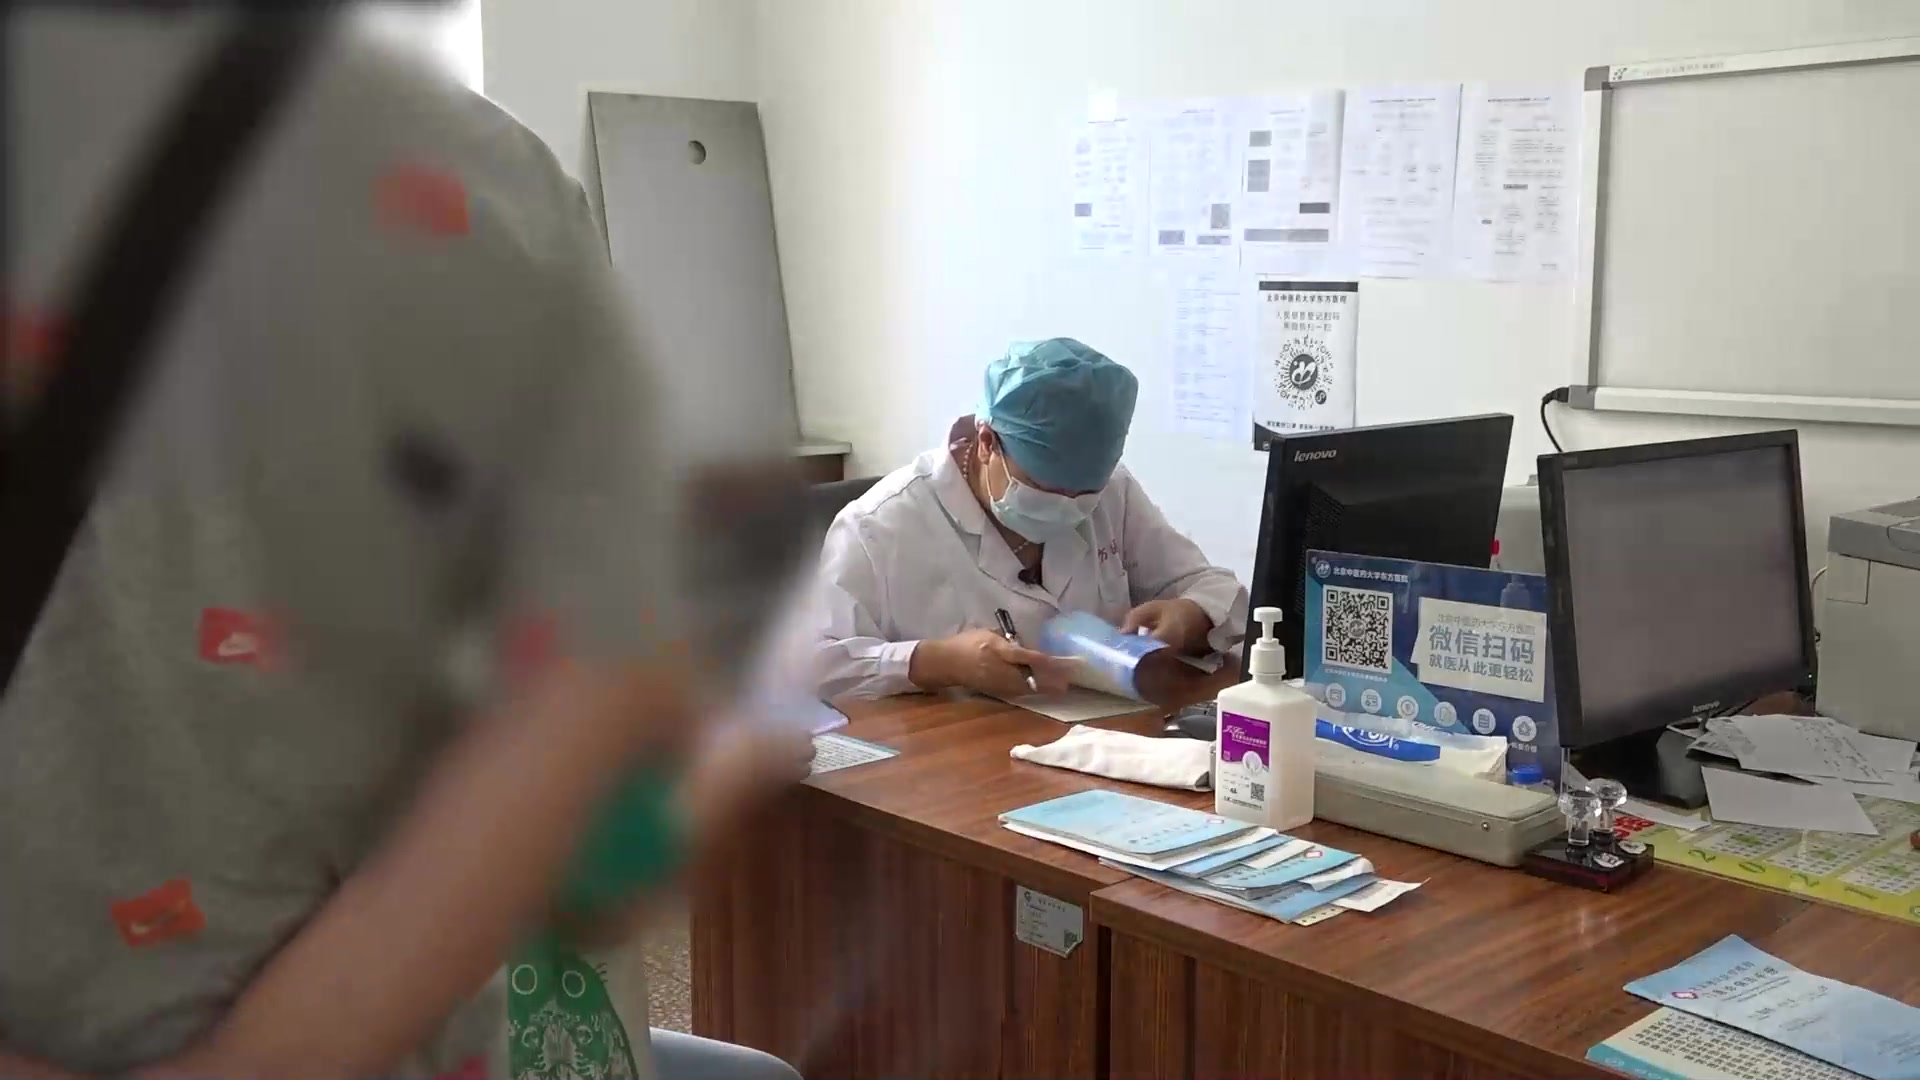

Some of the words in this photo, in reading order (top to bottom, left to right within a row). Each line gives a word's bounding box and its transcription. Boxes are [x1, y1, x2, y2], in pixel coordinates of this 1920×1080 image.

[1294, 450, 1337, 462] lenovo
[1333, 562, 1409, 583] 北京中医药大学东方医院
[1429, 624, 1535, 664] 微信扫码
[1429, 654, 1534, 682] 就医从此更轻松
